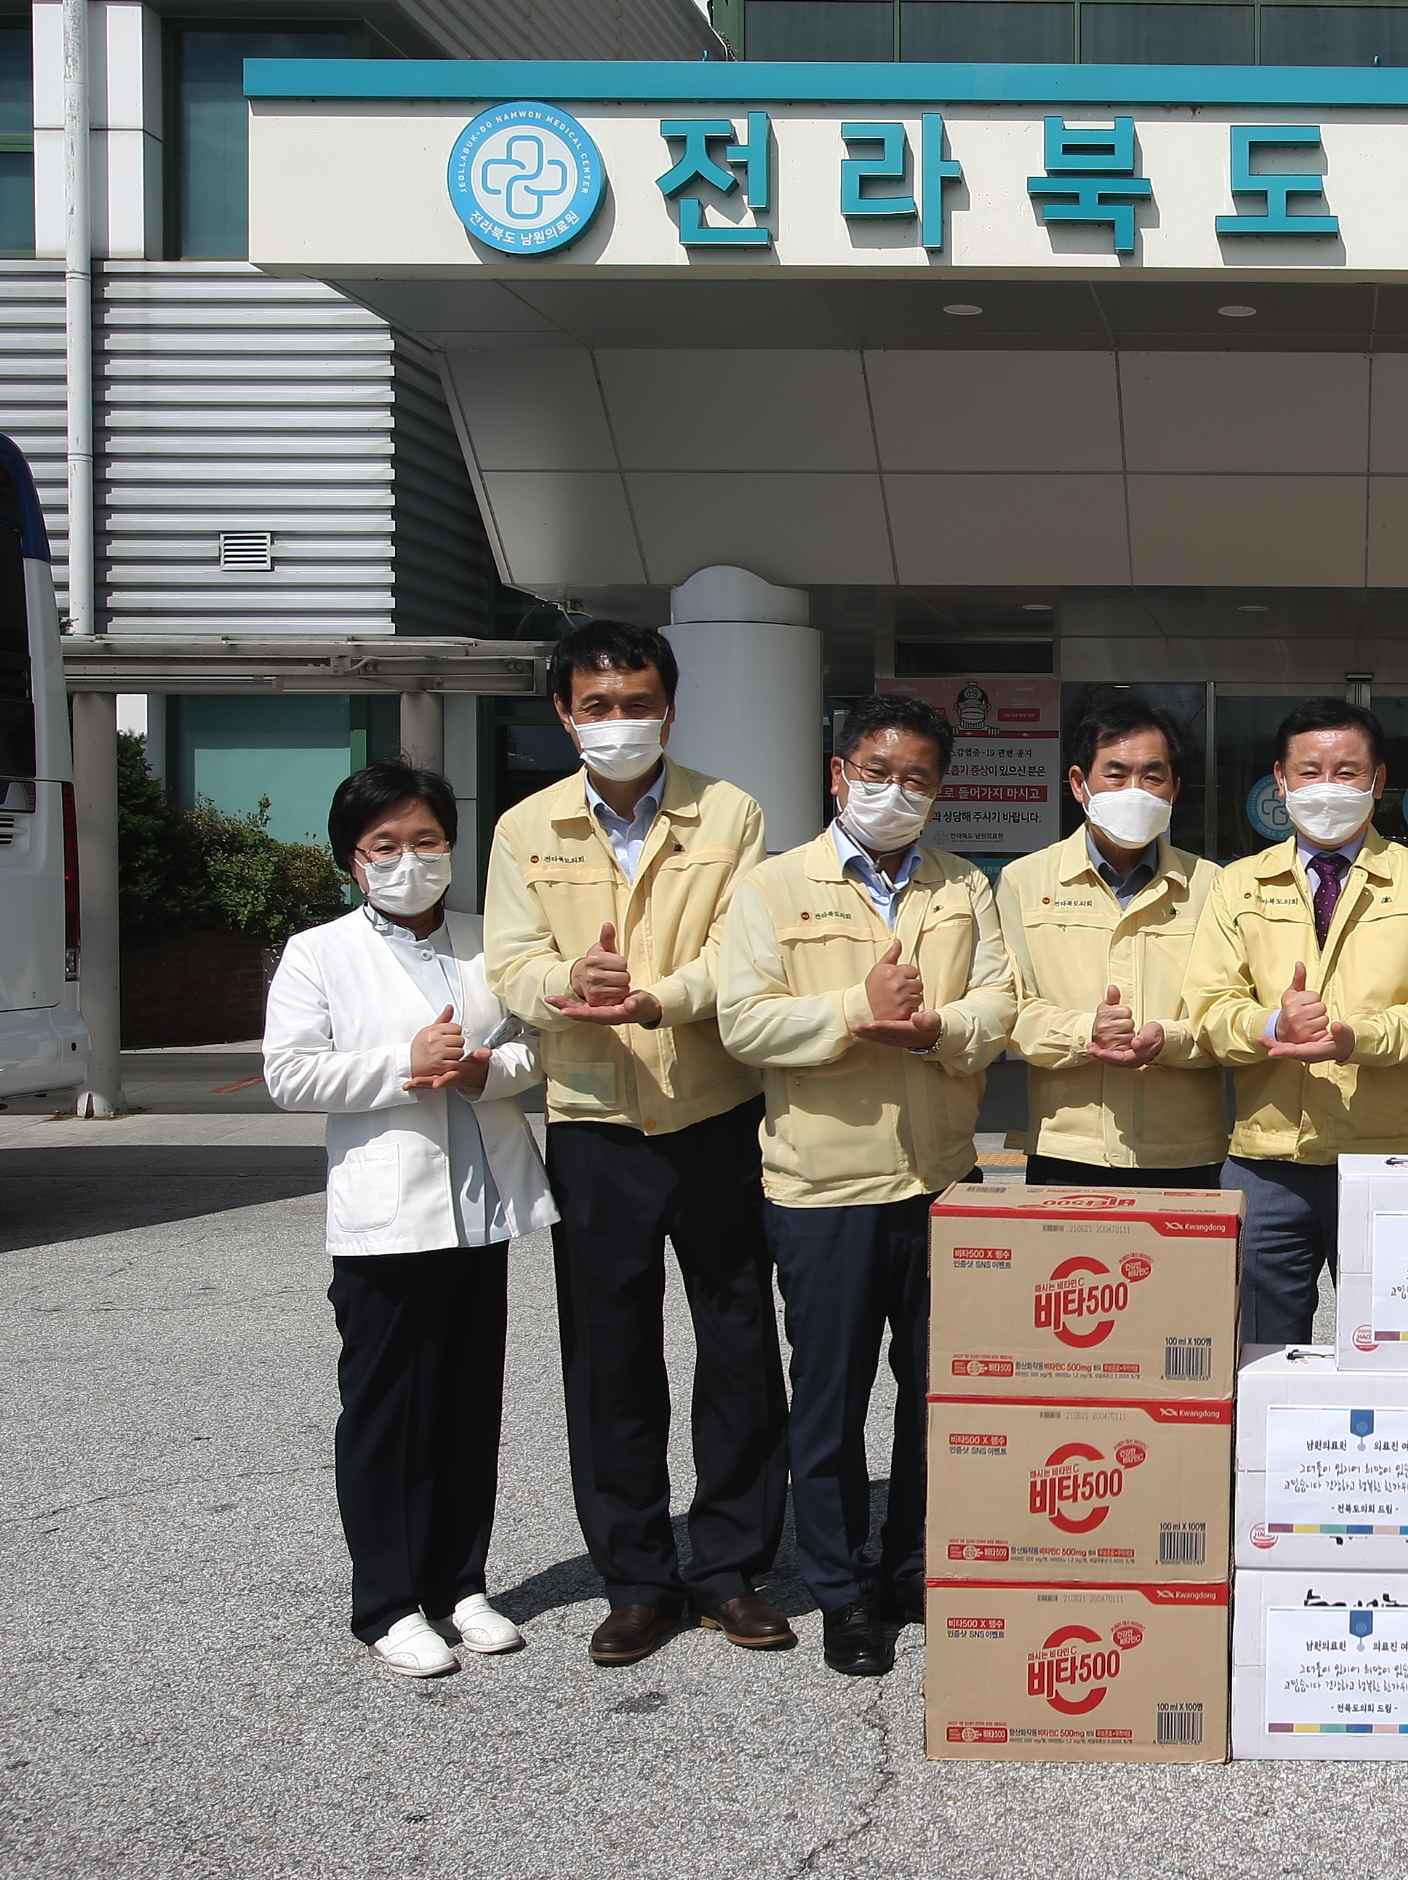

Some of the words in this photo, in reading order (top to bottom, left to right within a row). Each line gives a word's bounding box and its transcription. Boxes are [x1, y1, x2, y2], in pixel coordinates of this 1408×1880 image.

[457, 121, 493, 193] JEOLLABUK-DO
[495, 111, 542, 123] NAMWON
[545, 115, 582, 150] MEDICAL
[580, 153, 591, 194] CENTER
[469, 210, 516, 244] 전라북도
[520, 210, 581, 246] 남원의료원
[998, 748, 1013, 758] 관련
[1017, 749, 1032, 758] 공지
[970, 764, 997, 777] 증상이
[999, 765, 1026, 777] 있으신
[1027, 766, 1046, 777] 분은
[958, 786, 1003, 799] 들어가지
[1007, 787, 1040, 800] 마시고
[943, 811, 971, 823] 상담해
[973, 811, 1000, 823] 주시기
[1002, 812, 1041, 823] 바랍니다.
[950, 832, 974, 840] 전라북도
[975, 832, 1004, 840] 남원의료원
[1095, 1226, 1131, 1234] 200470111
[1185, 1222, 1226, 1233] Kwangdong
[954, 1249, 985, 1258] 비타500
[986, 1250, 993, 1258] X
[975, 1261, 991, 1269] SNS
[1034, 1284, 1055, 1293] 마시는
[1034, 1282, 1129, 1332] 비타500
[1165, 1337, 1178, 1346] 100
[1067, 1363, 1092, 1373] 500mg
[1179, 1408, 1221, 1419] Kwangdong
[950, 1435, 980, 1445] 비타500
[1307, 1439, 1346, 1451] 남원의료원
[1374, 1440, 1398, 1452] 의료진
[1030, 1470, 1050, 1479] 마시는
[1029, 1468, 1123, 1518] 비타500
[1338, 1503, 1375, 1514] 전북도의회
[1378, 1504, 1392, 1514] 드림
[1159, 1522, 1172, 1531] 100
[1175, 1590, 1216, 1601] Kwangdong
[948, 1619, 978, 1628] 비타500
[980, 1620, 986, 1628] X
[969, 1630, 985, 1638] SNS
[1306, 1640, 1346, 1652] 남원의료원
[1373, 1640, 1397, 1652] 의료진
[1027, 1652, 1048, 1662] 마시는
[1027, 1650, 1120, 1698] 비타500
[1157, 1703, 1169, 1711] 100
[1337, 1703, 1374, 1713] 전북도의회
[1377, 1703, 1391, 1713] 드림
[1060, 1729, 1085, 1738] 500mg
